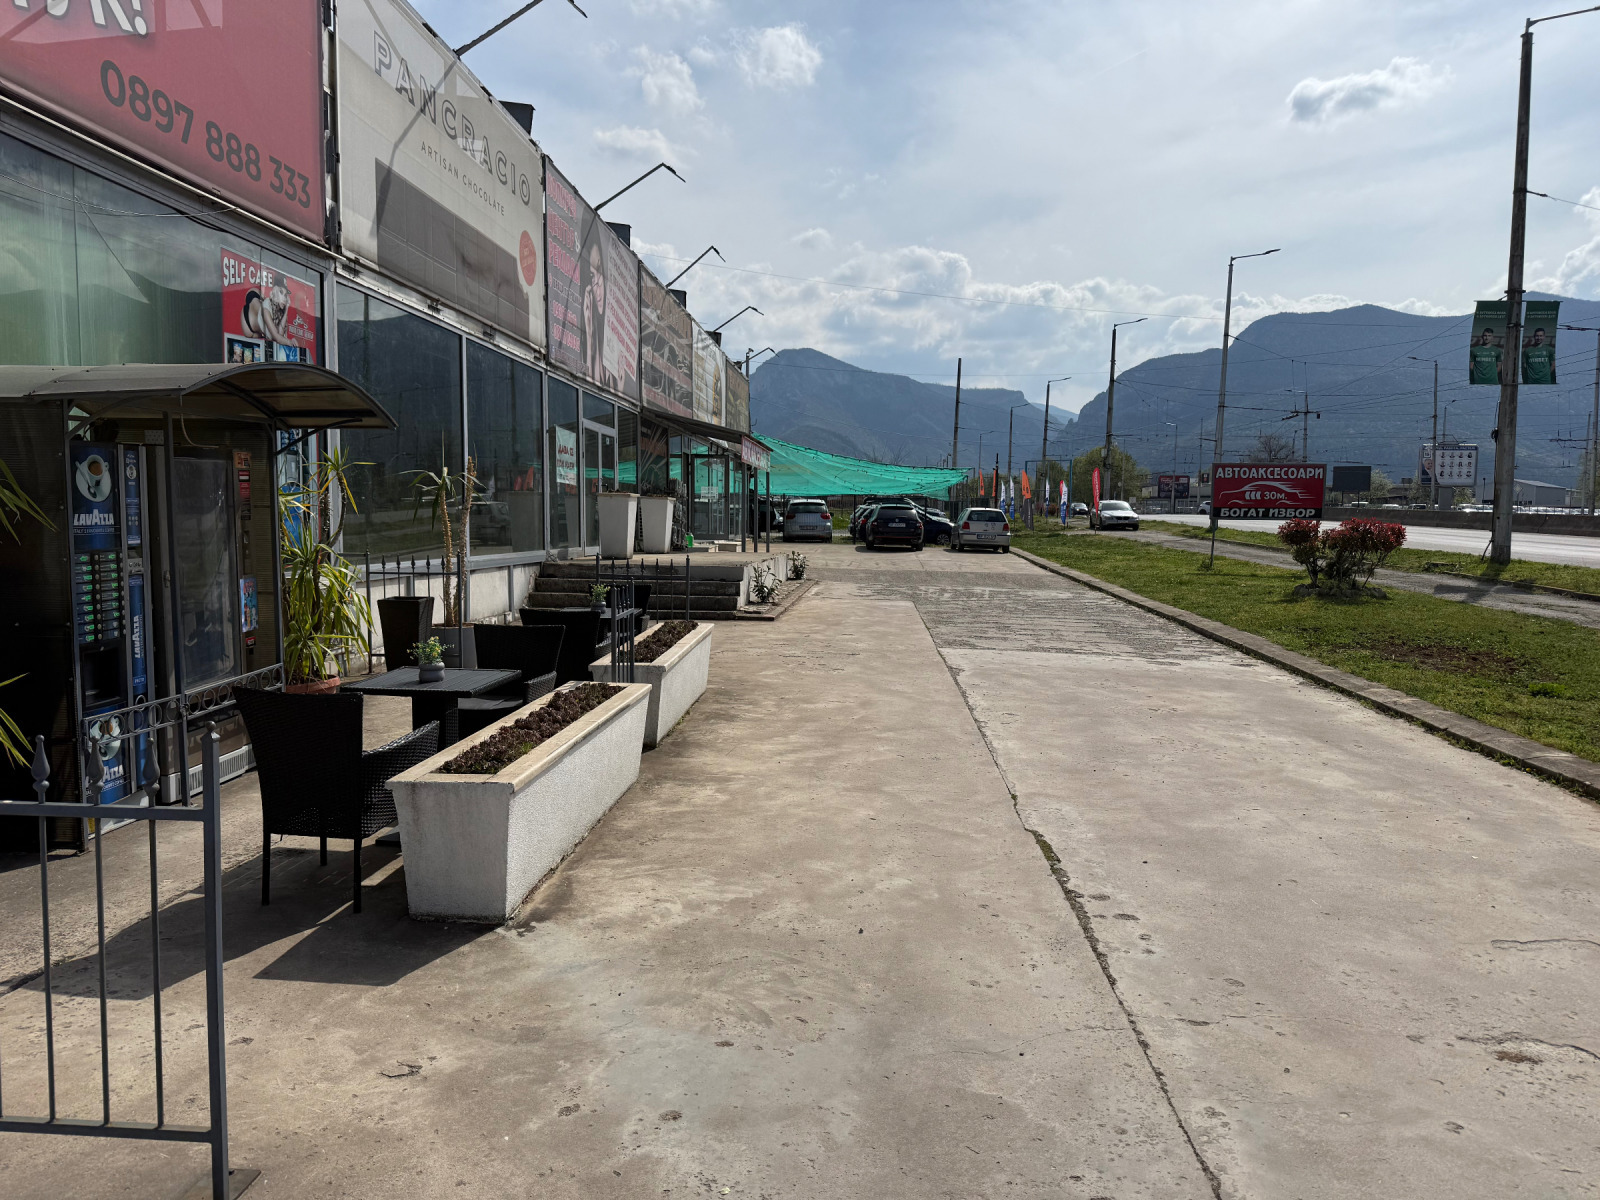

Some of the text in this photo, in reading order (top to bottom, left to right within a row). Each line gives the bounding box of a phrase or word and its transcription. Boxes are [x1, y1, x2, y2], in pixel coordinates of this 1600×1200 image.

[100, 60, 311, 208] 0897 888 333
[373, 30, 531, 206] PANCRACIO
[420, 141, 505, 216] ARTISAN CHOCOLATE
[222, 256, 273, 288] SELF CAFE
[1215, 467, 1324, 479] АВТОАКСЕСОАРИ
[73, 509, 115, 526] LAVAZZA
[1220, 508, 1315, 518] БОГАТ ИЗБОР
[132, 614, 141, 659] LAVAZZA
